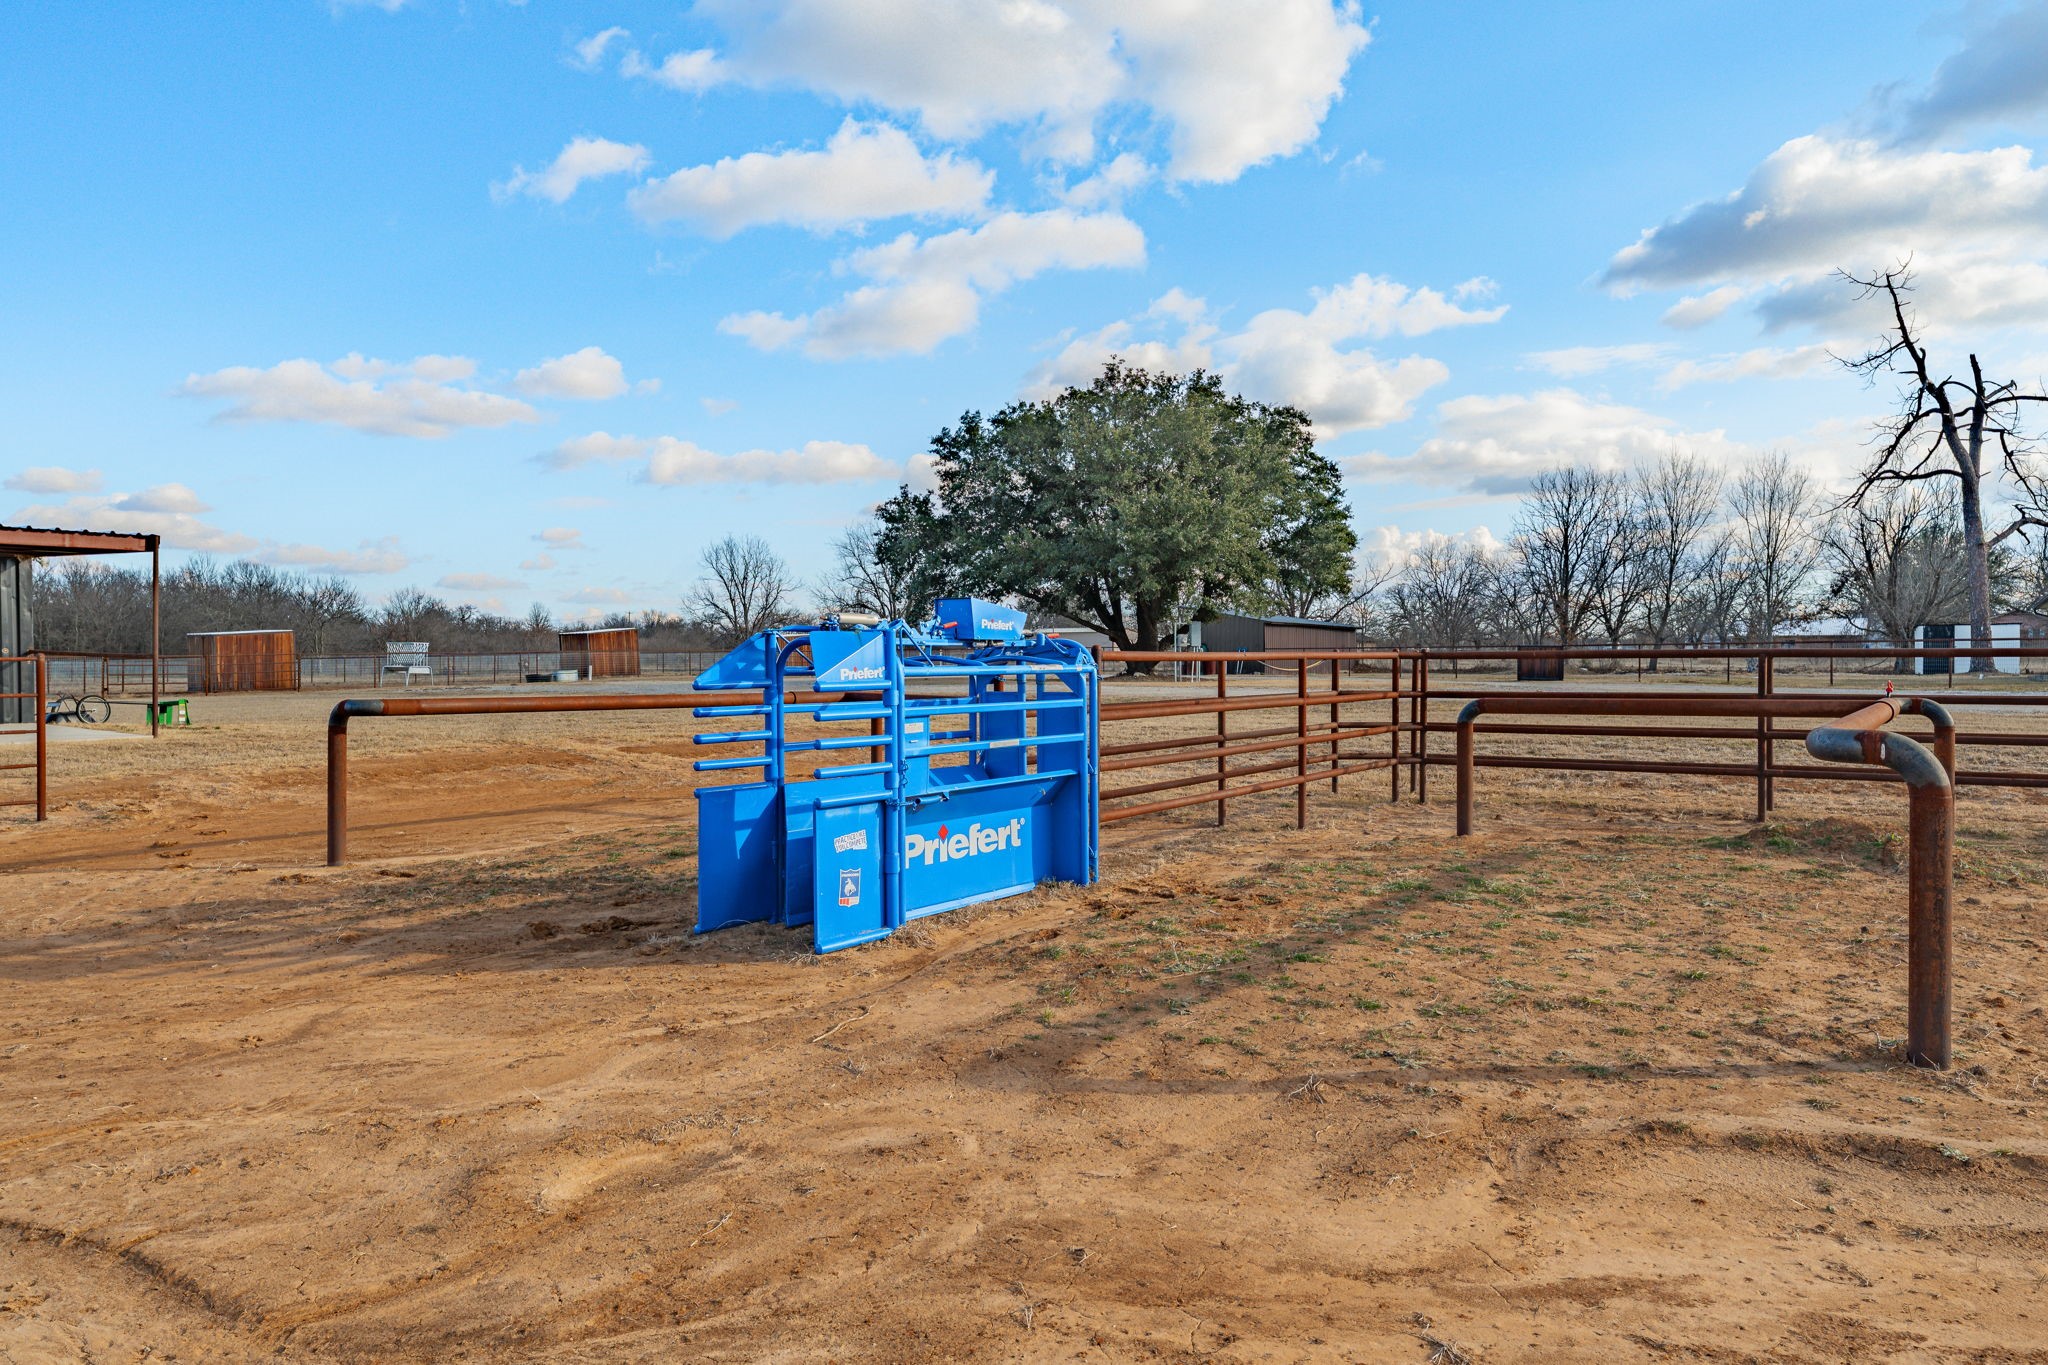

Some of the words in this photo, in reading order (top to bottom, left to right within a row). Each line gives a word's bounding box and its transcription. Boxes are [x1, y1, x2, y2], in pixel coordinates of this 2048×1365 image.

[981, 618, 1013, 630] Priefert
[840, 666, 883, 680] Priefert
[904, 818, 1022, 869] Priefert
